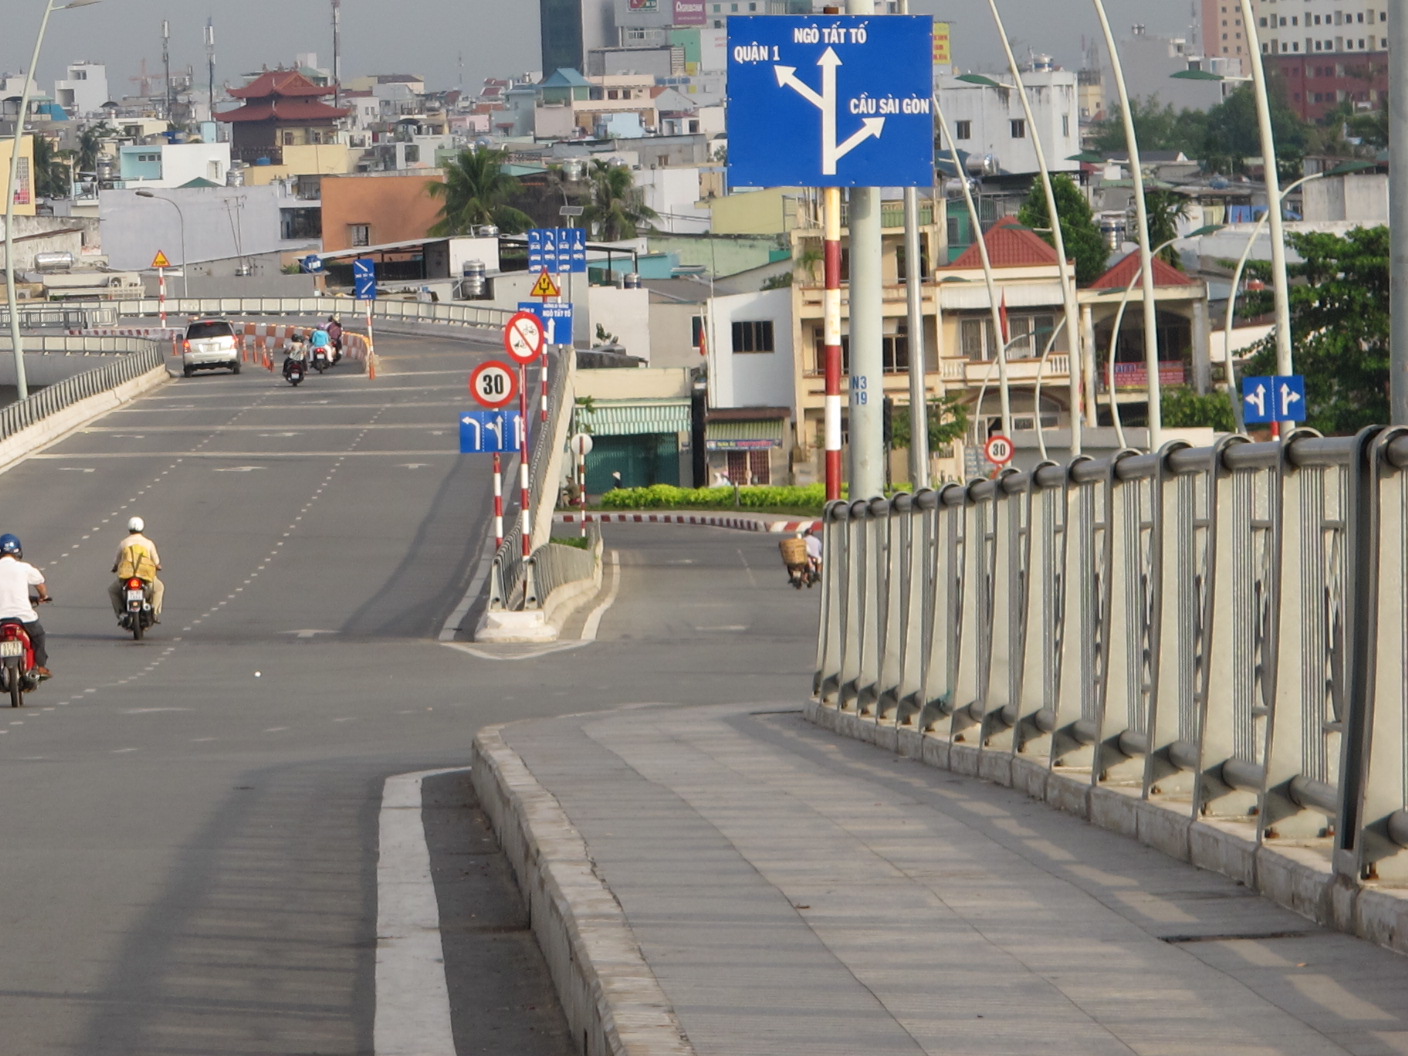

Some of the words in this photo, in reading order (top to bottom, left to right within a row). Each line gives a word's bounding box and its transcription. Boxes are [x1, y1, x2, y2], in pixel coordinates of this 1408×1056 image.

[794, 23, 820, 44] NGÔ
[822, 20, 846, 44] TẤT
[850, 20, 869, 44] TỐ
[734, 41, 769, 65] QUẬN
[773, 45, 780, 61] 1
[850, 91, 876, 115] CẦU
[879, 93, 900, 114] SÀI
[903, 93, 930, 114] GÒN
[483, 374, 504, 395] 30
[852, 375, 868, 390] N3
[855, 390, 868, 405] 19
[992, 443, 1006, 456] 30
